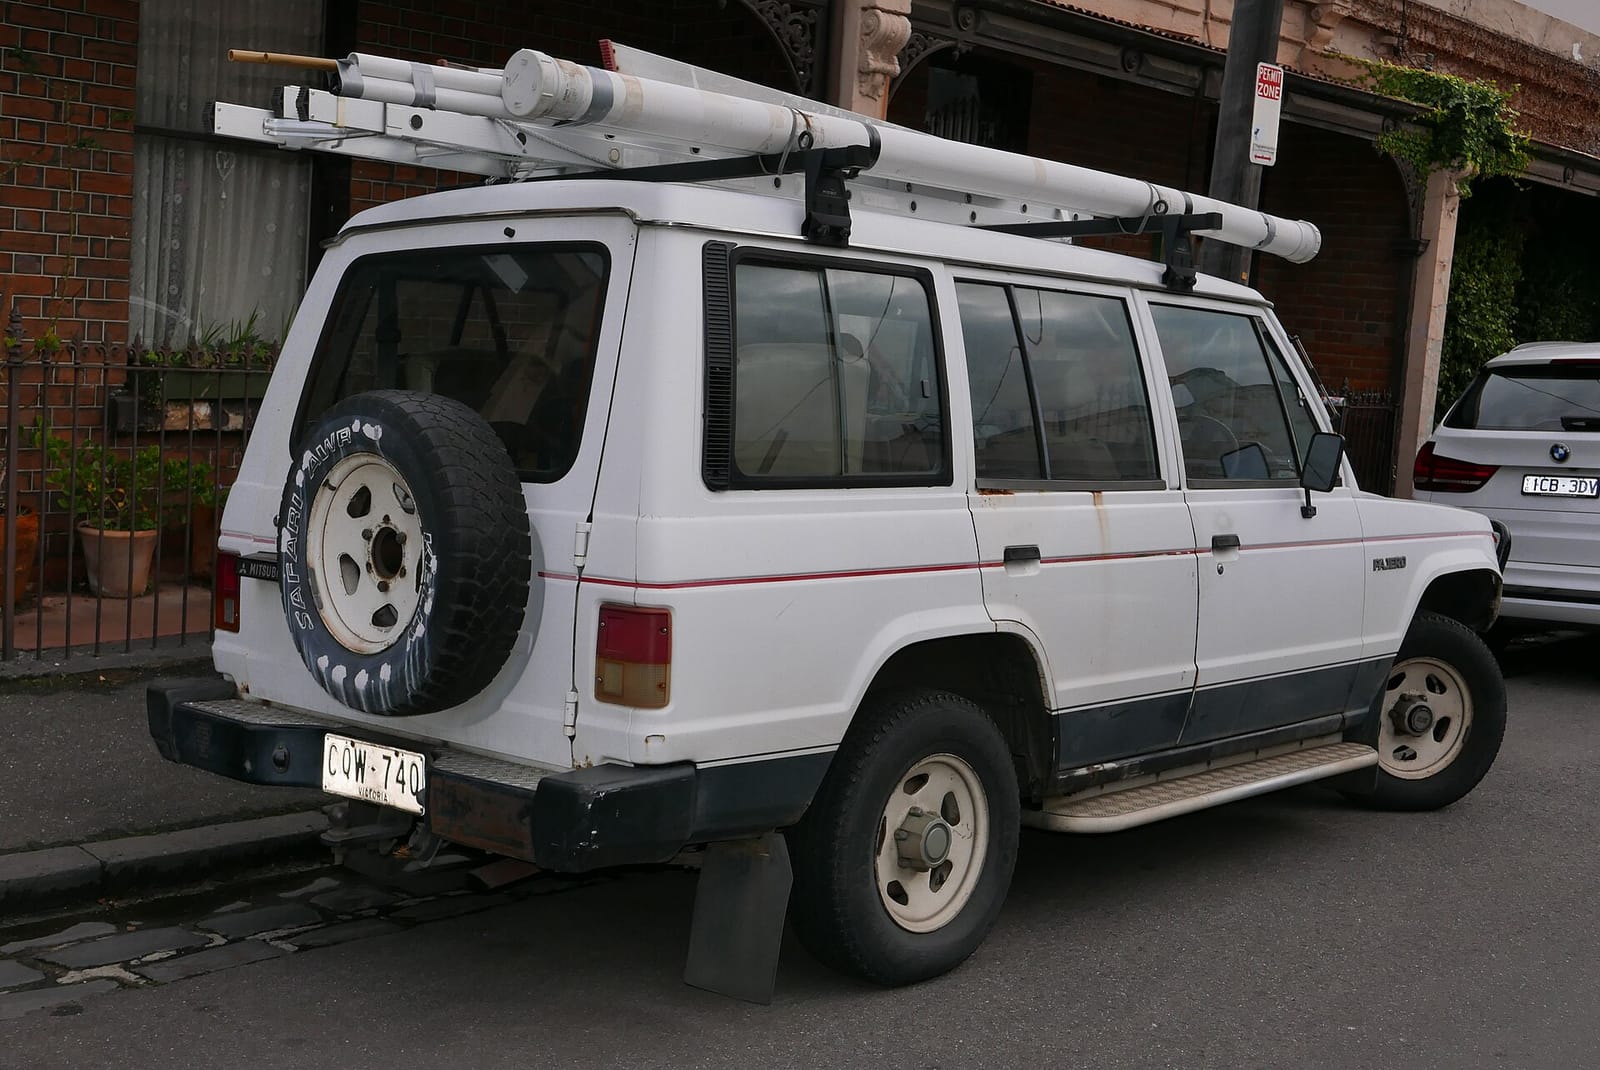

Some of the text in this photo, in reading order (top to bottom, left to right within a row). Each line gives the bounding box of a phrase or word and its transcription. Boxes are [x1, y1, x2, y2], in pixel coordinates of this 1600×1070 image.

[1259, 67, 1282, 83] PERMIT
[1257, 83, 1280, 99] ZONE
[286, 426, 352, 630] SAFARI AWR
